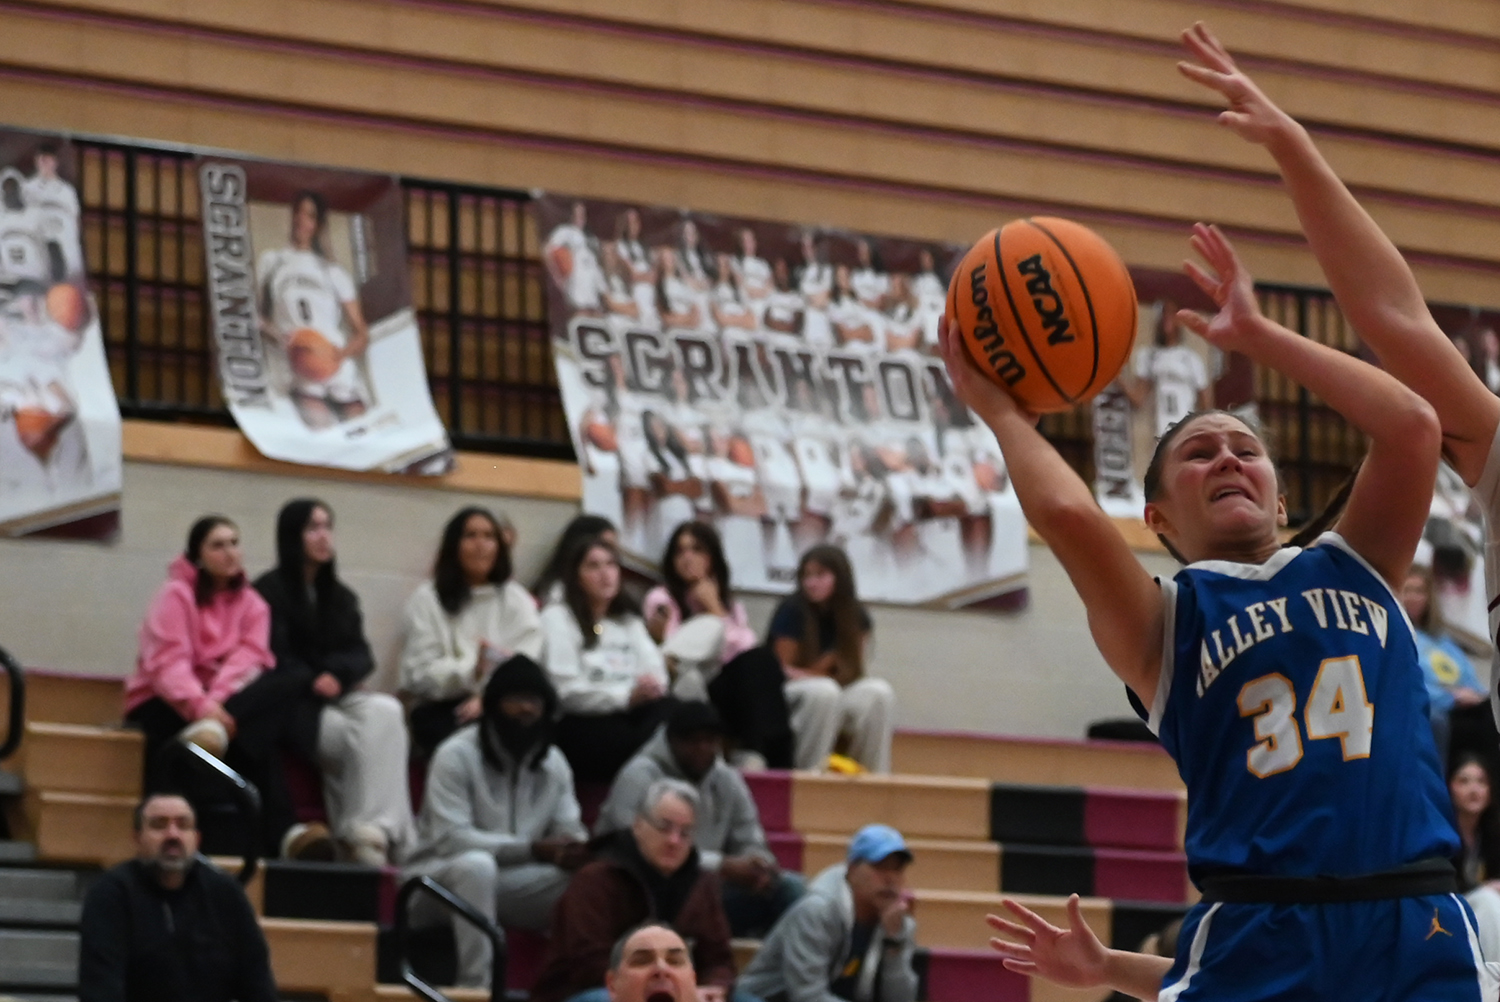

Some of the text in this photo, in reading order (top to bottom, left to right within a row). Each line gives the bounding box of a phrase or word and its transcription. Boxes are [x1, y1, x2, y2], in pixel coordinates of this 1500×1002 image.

[970, 263, 1027, 388] Wilson
[1017, 253, 1076, 346] NCAA
[569, 320, 977, 429] SCRANTON
[1196, 588, 1389, 698] ALLEY VIEW
[1236, 654, 1375, 779] 34
